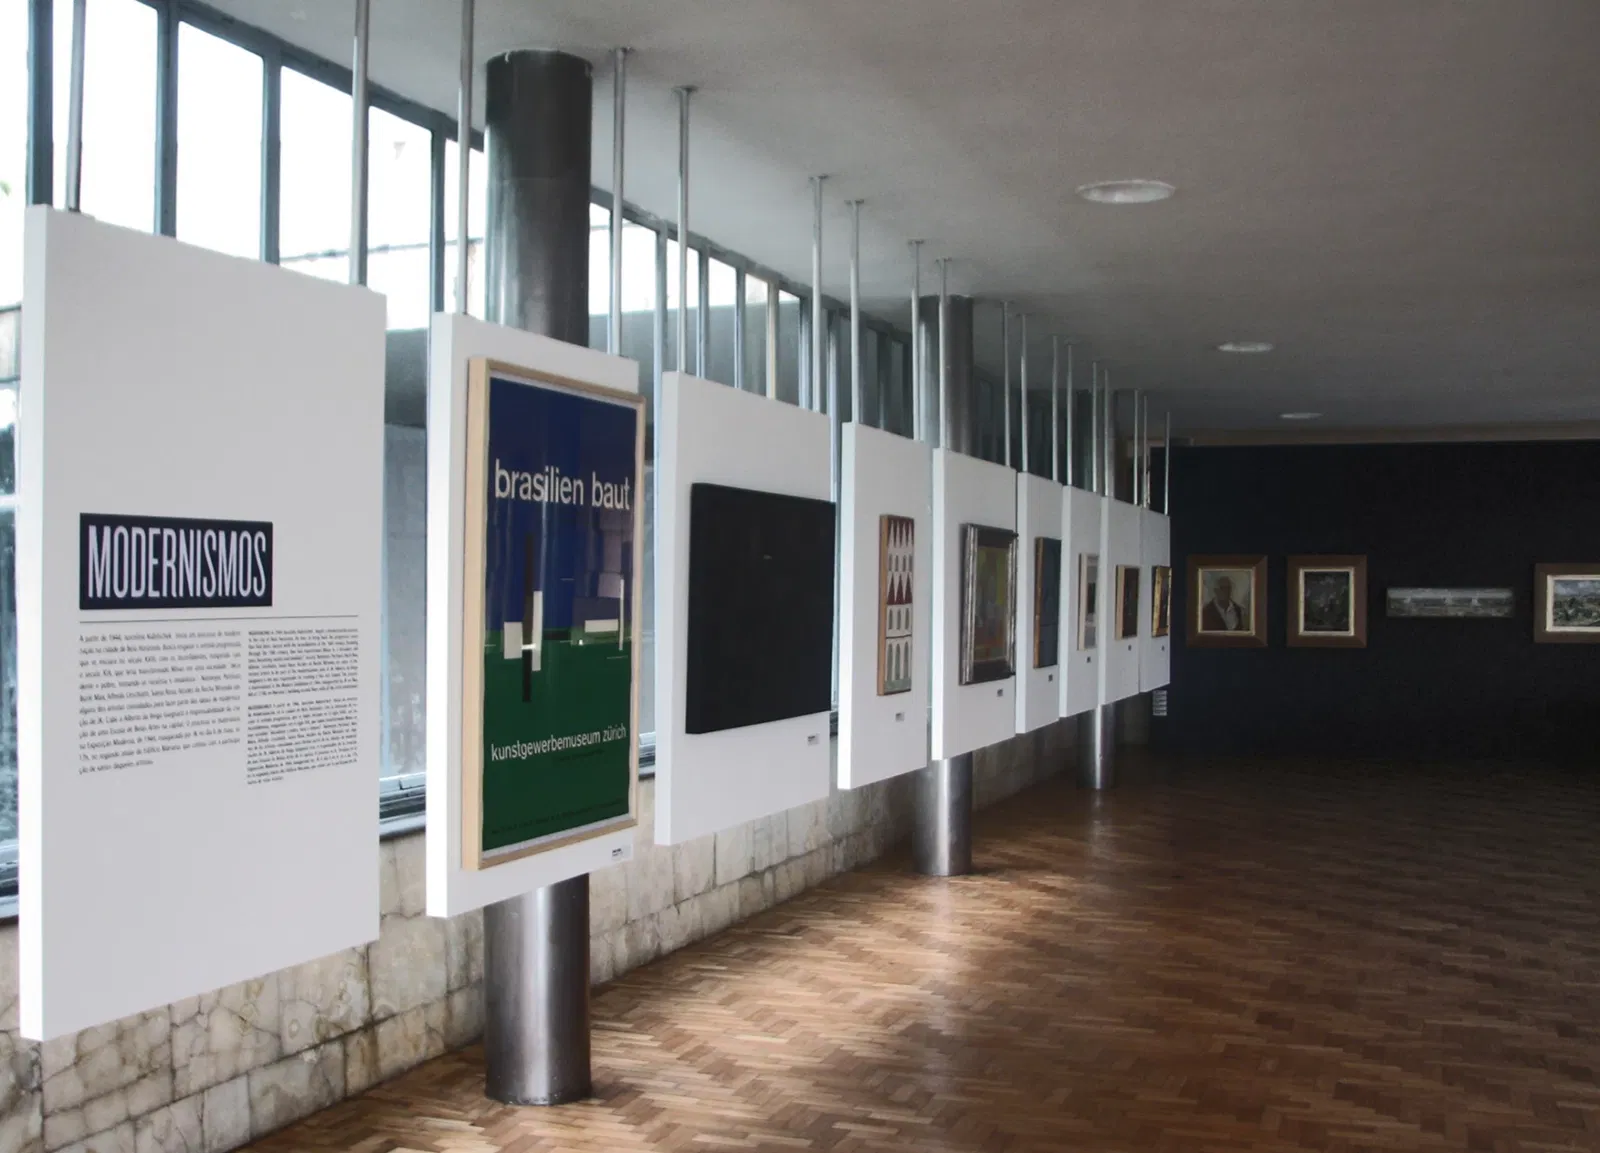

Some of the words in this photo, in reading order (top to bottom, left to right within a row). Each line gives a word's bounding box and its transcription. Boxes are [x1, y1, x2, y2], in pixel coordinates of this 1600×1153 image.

[494, 457, 585, 506] brasilien
[591, 469, 631, 511] baut
[88, 524, 267, 599] MODERNISMOS
[491, 730, 601, 762] kunstgewerbemuseum
[602, 722, 627, 743] zürich
